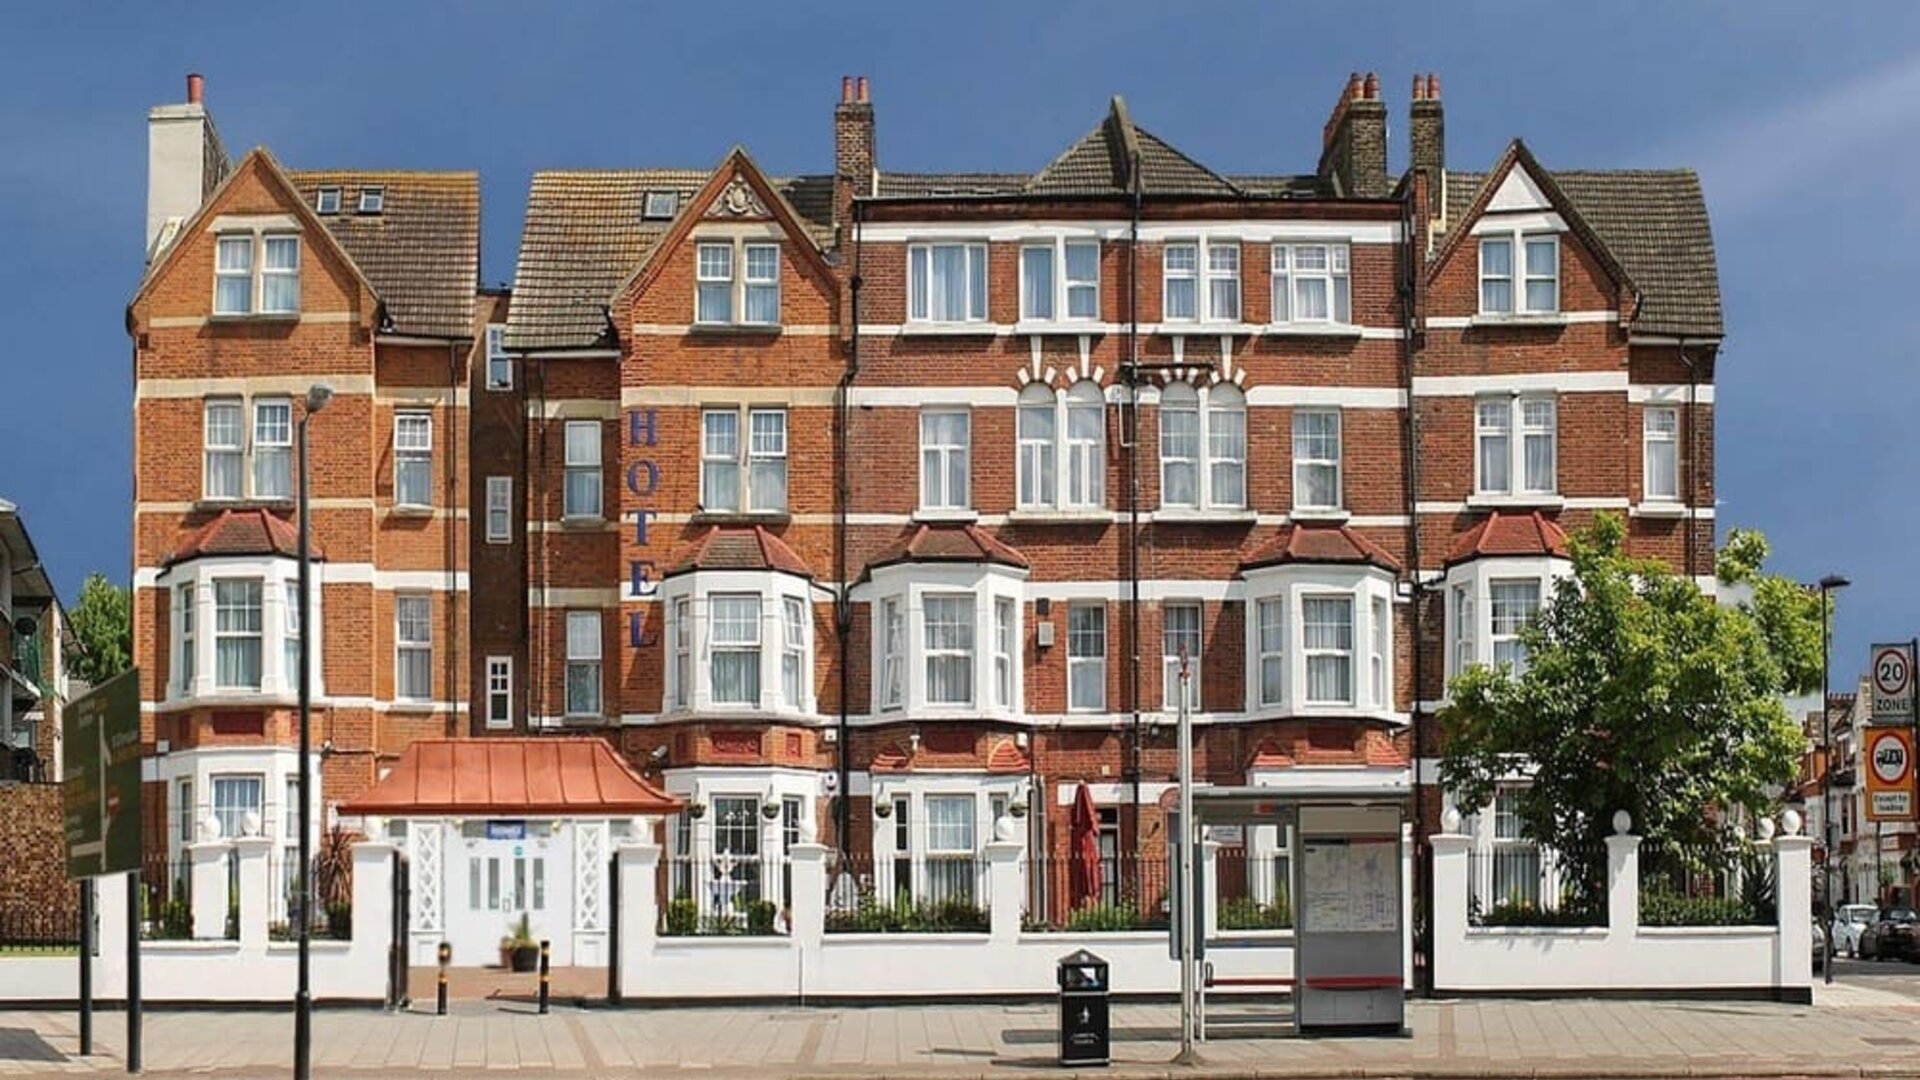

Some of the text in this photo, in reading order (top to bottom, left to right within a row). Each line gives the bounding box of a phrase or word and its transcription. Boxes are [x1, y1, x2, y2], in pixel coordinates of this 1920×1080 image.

[627, 410, 660, 648] HOTEL
[1882, 664, 1903, 681] 20
[1877, 699, 1909, 711] ZONE
